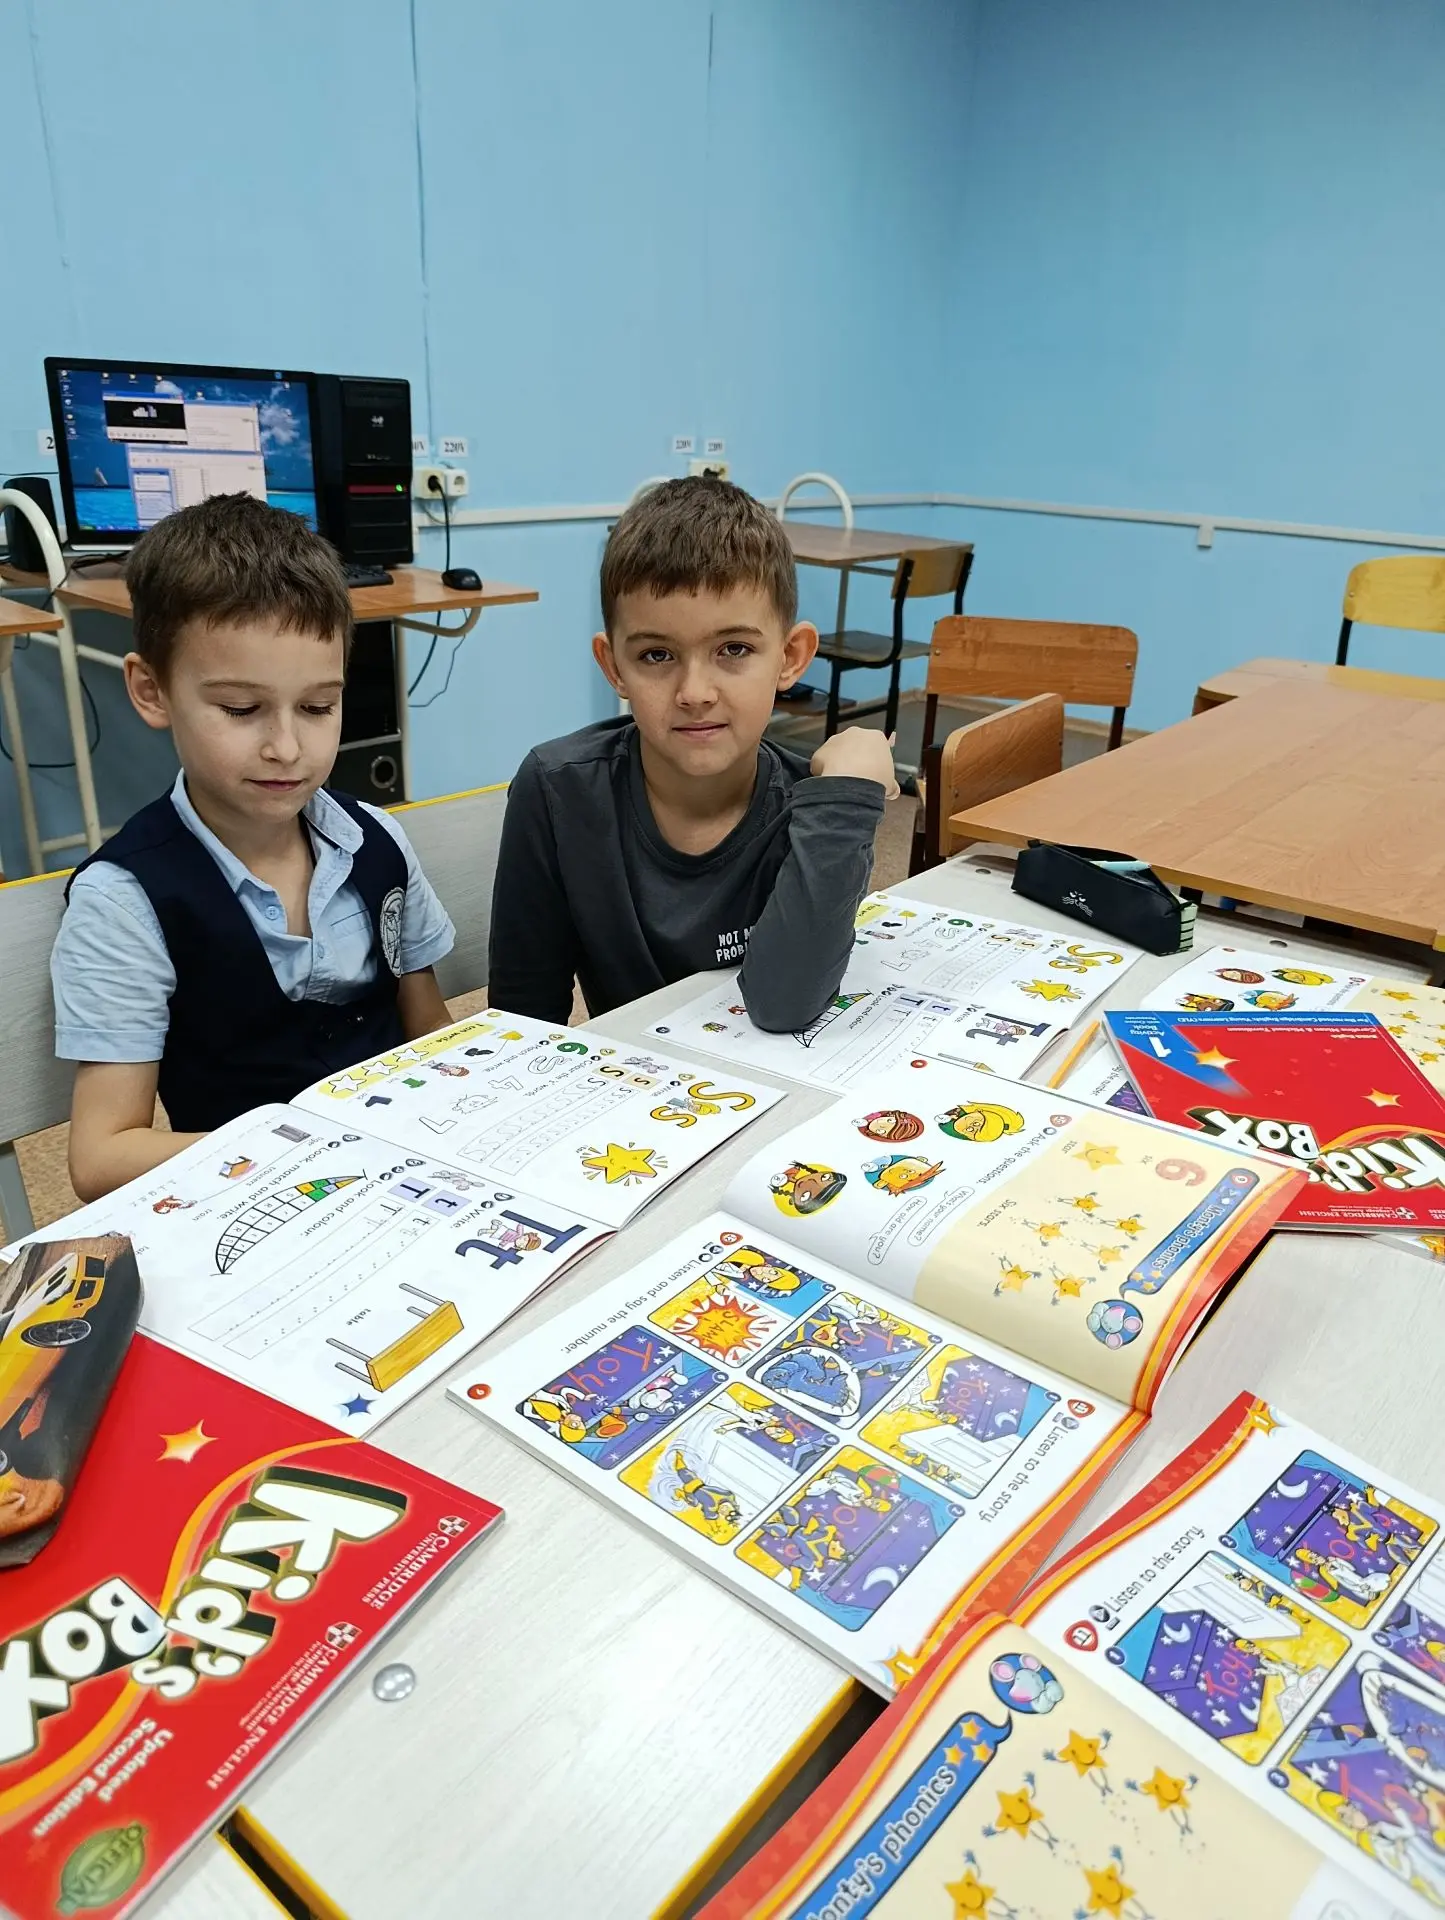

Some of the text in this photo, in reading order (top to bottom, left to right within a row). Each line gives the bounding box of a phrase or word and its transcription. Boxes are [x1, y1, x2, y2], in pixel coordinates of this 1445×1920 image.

[715, 942, 749, 962] PROBL
[718, 930, 739, 947] NOT
[1130, 1029, 1165, 1037] Activity
[1148, 1036, 1173, 1058] 1
[975, 1133, 1048, 1186] Ask the questions.
[1060, 1140, 1078, 1155] star
[246, 1166, 277, 1187] trousers
[248, 1185, 269, 1202] and
[270, 1164, 300, 1186] match
[399, 1183, 431, 1199] T
[1155, 1157, 1208, 1188] 6
[191, 1208, 213, 1222] train
[216, 1200, 249, 1221] write.
[300, 1179, 379, 1238] Look and colour.
[450, 1208, 482, 1230] Write.
[872, 1198, 923, 1260] How old are you?
[914, 1189, 969, 1242] What's your name?
[976, 1199, 1018, 1229] Six stars.
[1342, 1211, 1399, 1219] CAMBRIDGE
[1152, 1203, 1226, 1270] Monty's phonics
[346, 1308, 372, 1326] table
[560, 1259, 702, 1354] Listen and say the number.
[979, 1425, 1069, 1523] Listen to the story
[130, 1476, 405, 1699] Kid's
[361, 1532, 439, 1604] UNIVERSITY PRESS
[370, 1536, 450, 1611] CAMBRIDGE
[1103, 1525, 1206, 1613] Listen to the story
[246, 1644, 330, 1732] Language Assessment
[206, 1648, 340, 1791] CAMBRIDGE ENGLISH
[31, 1717, 157, 1838] Second Edition
[98, 1728, 174, 1804] Updated
[880, 1765, 957, 1864] phonics
